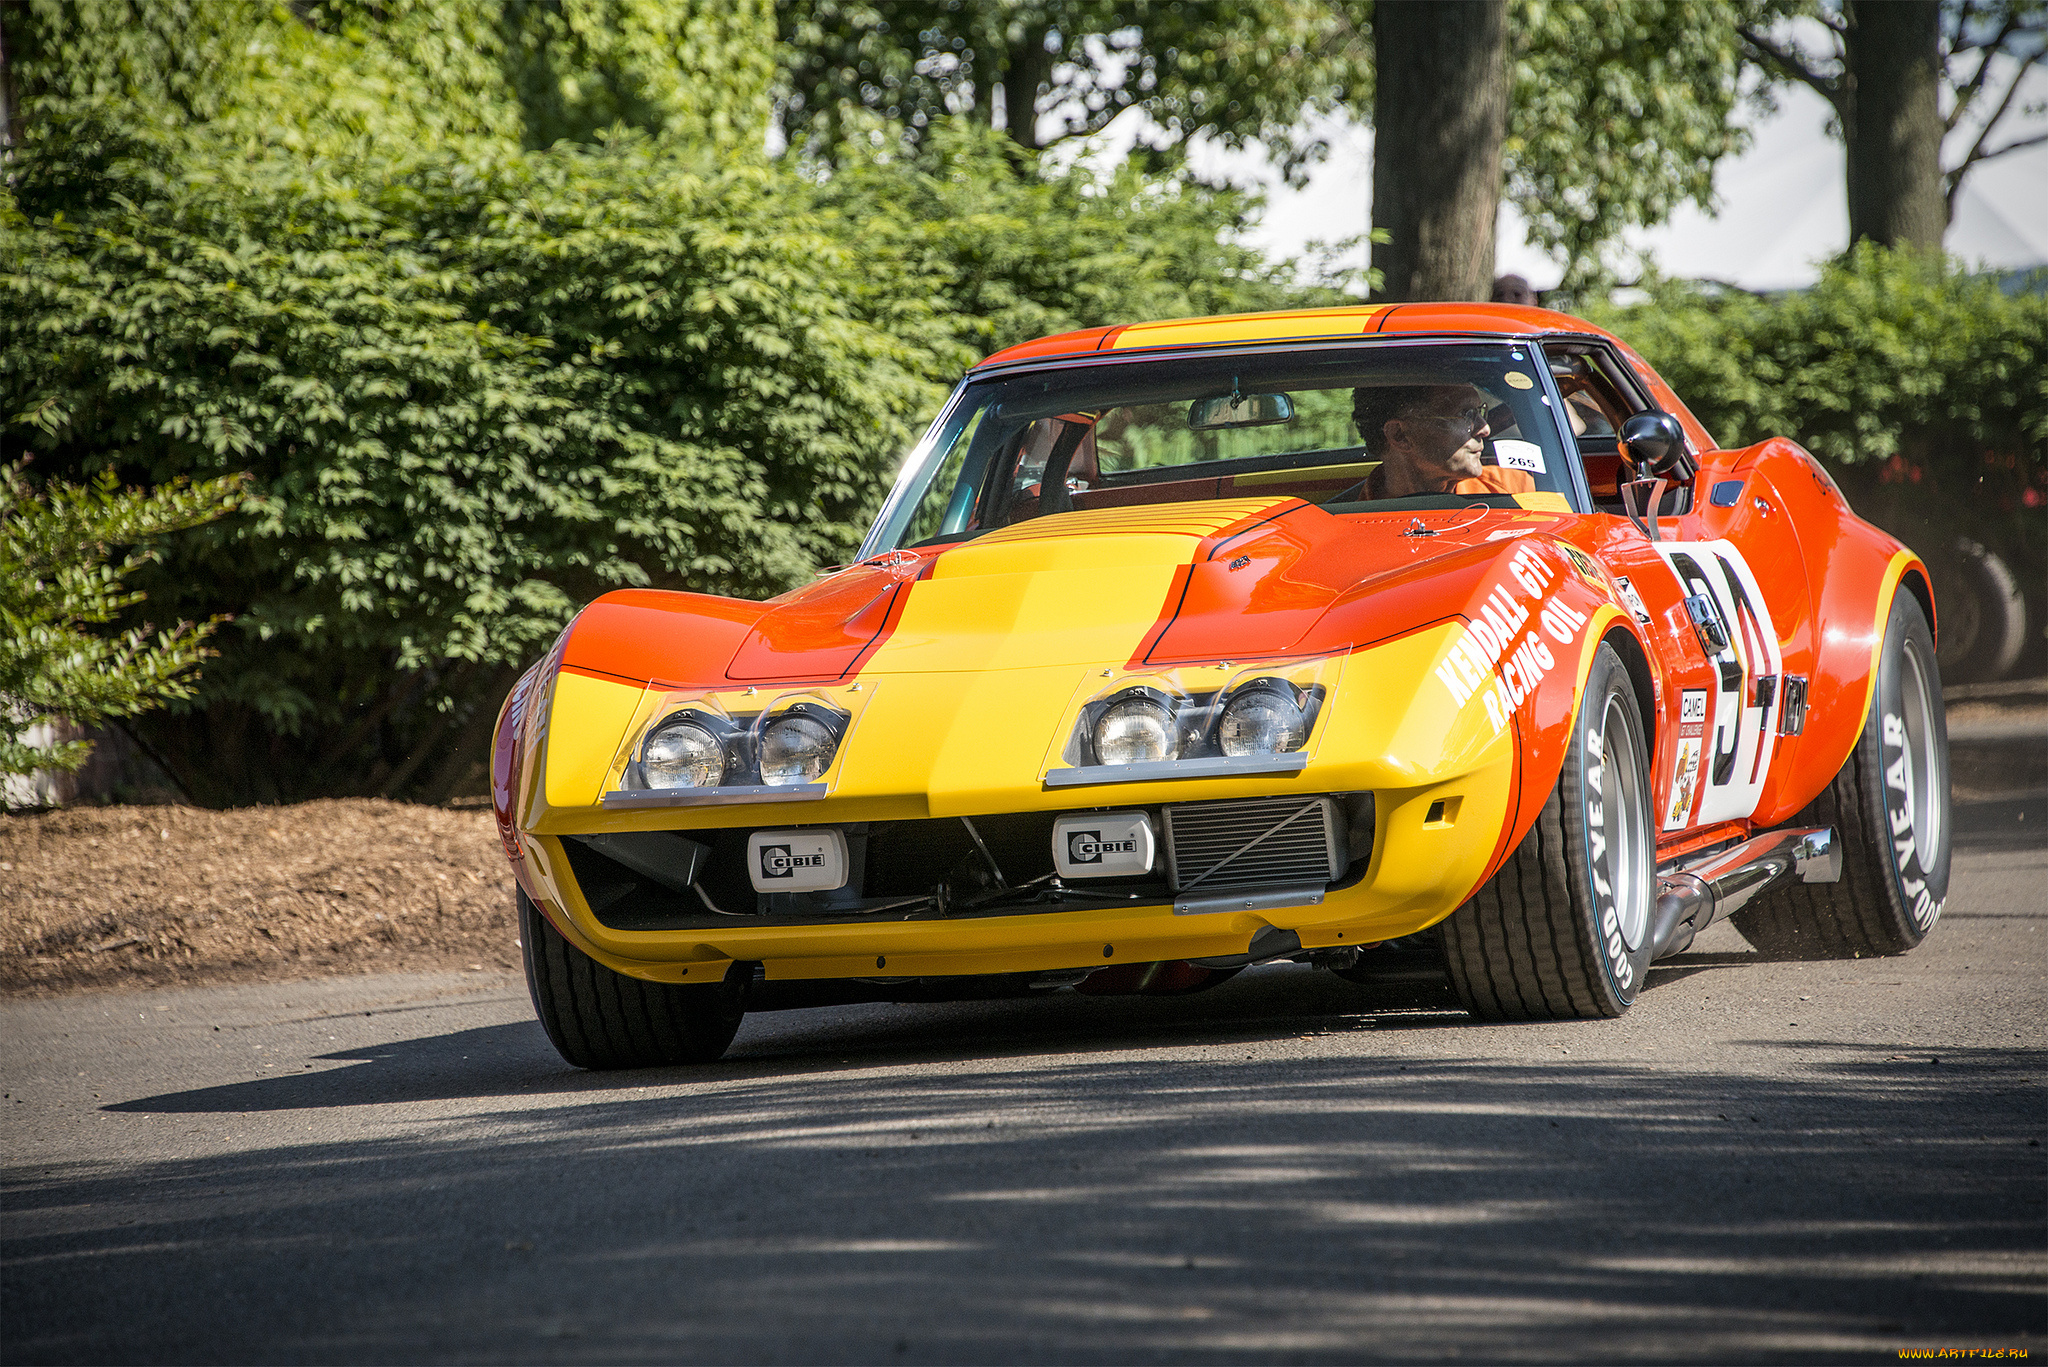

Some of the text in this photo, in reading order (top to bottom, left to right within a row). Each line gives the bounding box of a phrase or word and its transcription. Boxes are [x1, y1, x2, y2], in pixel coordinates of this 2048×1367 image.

[1508, 457, 1536, 468] 265
[1435, 583, 1530, 709] KENDALL
[1482, 630, 1555, 735] RACING
[1540, 596, 1587, 645] OIL
[1683, 698, 1704, 717] CAMEL
